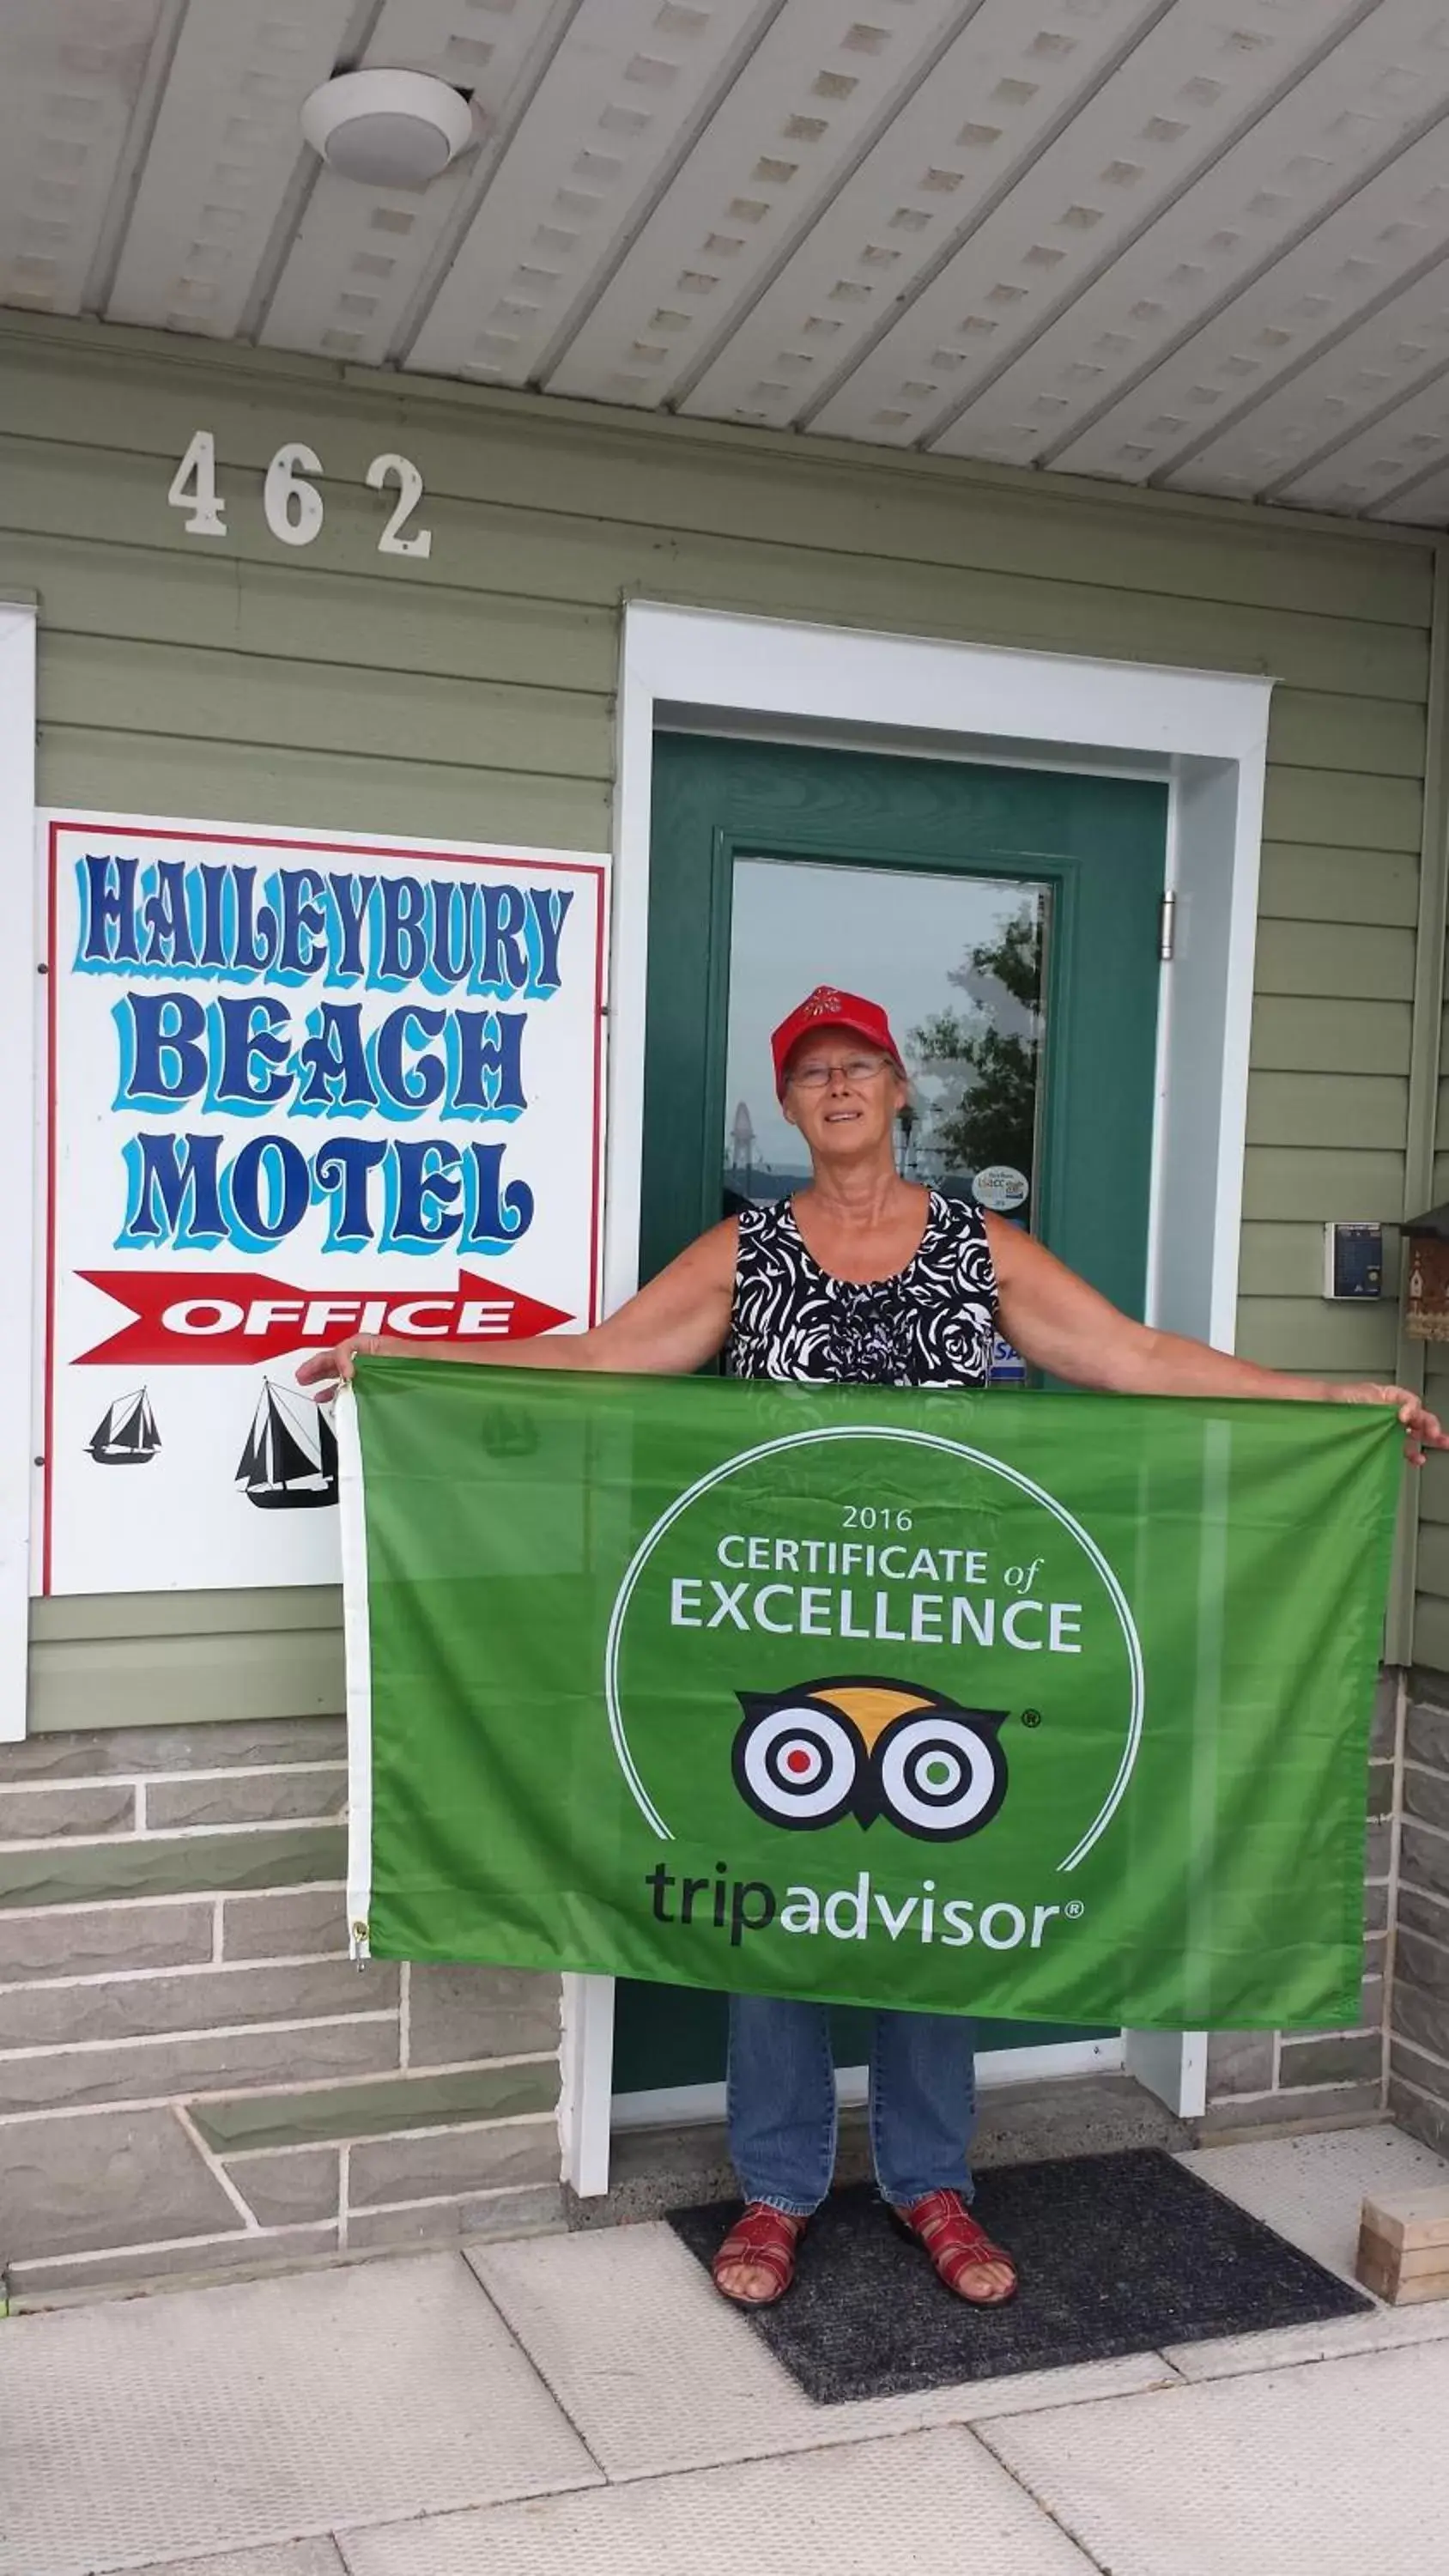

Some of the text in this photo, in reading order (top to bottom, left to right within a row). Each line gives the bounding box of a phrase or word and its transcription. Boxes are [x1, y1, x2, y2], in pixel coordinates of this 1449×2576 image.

[167, 430, 431, 558] 462
[71, 854, 574, 1000] HAILEYBURY
[111, 991, 528, 1123] BEACH
[112, 1132, 535, 1255] MOTEL
[161, 1299, 515, 1336] OFFICE
[994, 1342, 1022, 1360] SA
[841, 1505, 913, 1532] 2016
[716, 1534, 1046, 1595] CERTIFICATE of
[670, 1577, 1083, 1654] EXCELLENCE
